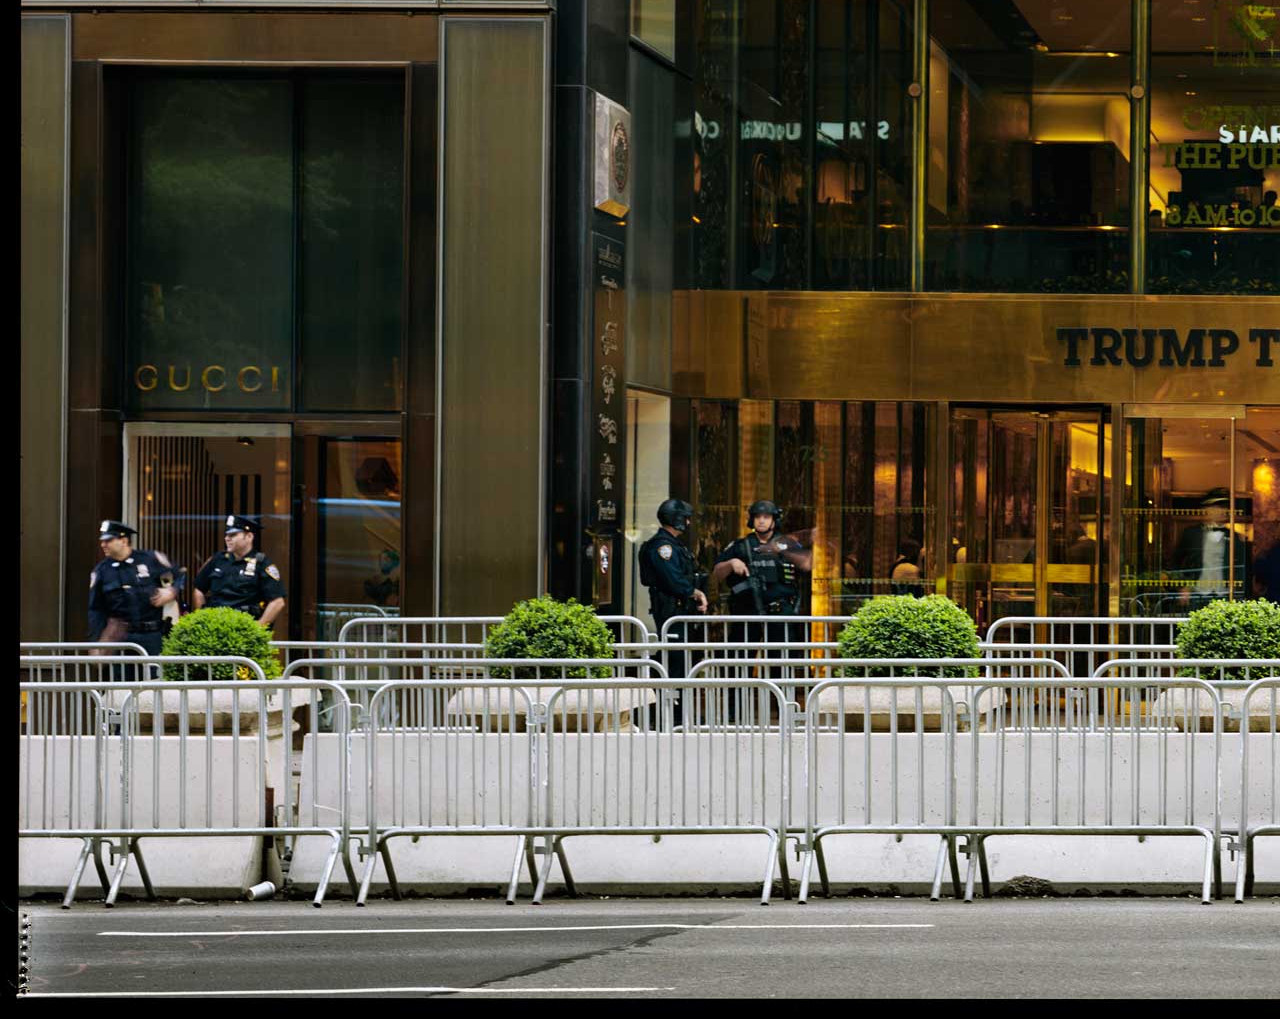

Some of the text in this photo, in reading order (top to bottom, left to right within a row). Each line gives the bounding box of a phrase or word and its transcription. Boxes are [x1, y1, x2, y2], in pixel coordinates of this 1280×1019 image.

[1158, 143, 1221, 169] THE
[1056, 327, 1240, 368] TRUMP
[134, 364, 280, 392] GUCCI
